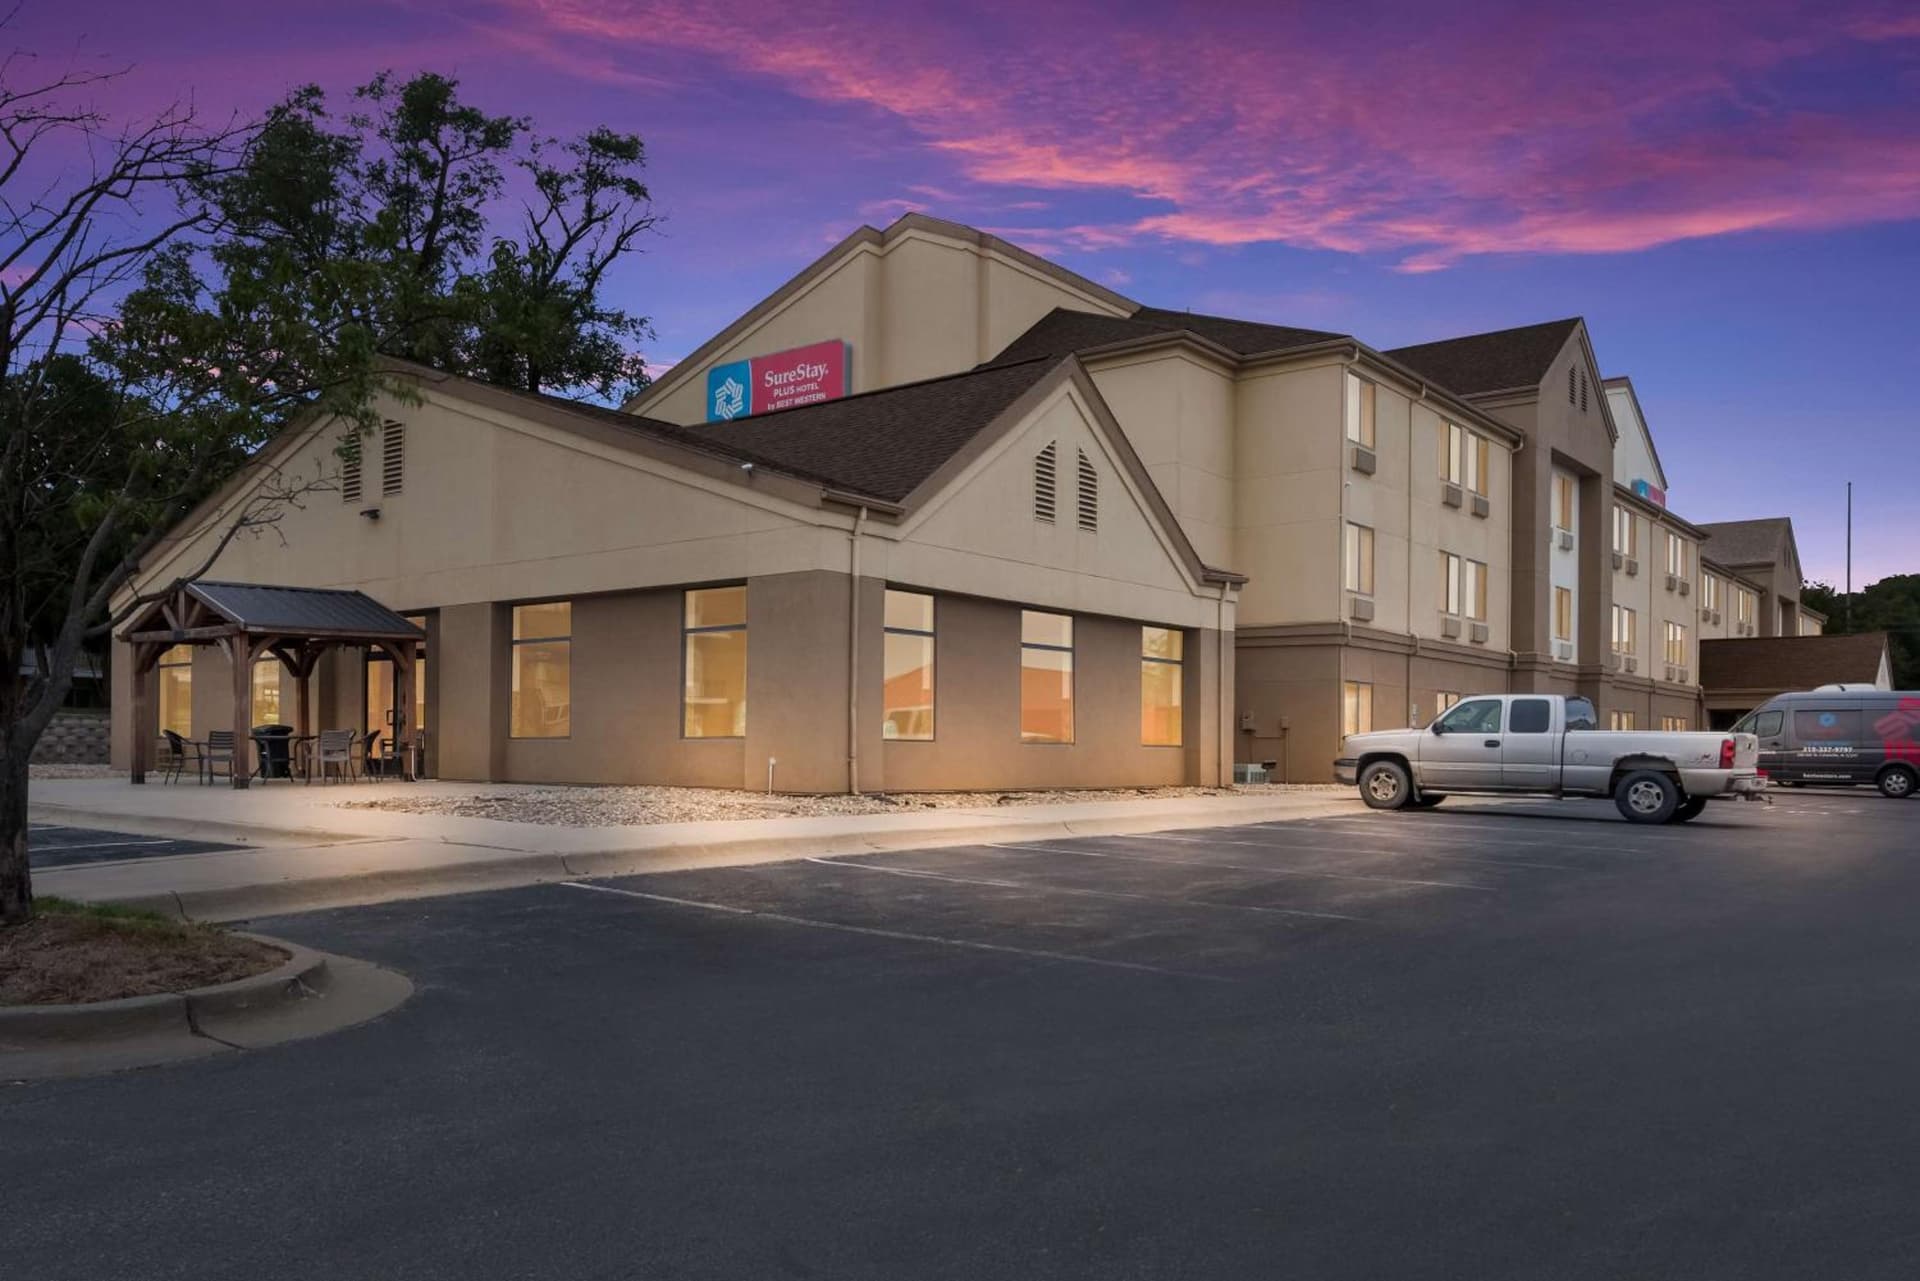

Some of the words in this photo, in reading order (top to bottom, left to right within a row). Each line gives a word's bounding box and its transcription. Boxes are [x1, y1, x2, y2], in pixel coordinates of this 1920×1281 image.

[764, 363, 827, 388] SureStay
[773, 386, 795, 397] PLUS
[797, 382, 819, 392] HOTEL
[767, 403, 775, 411] by
[776, 399, 793, 408] BEST
[795, 393, 826, 405] WESTERN
